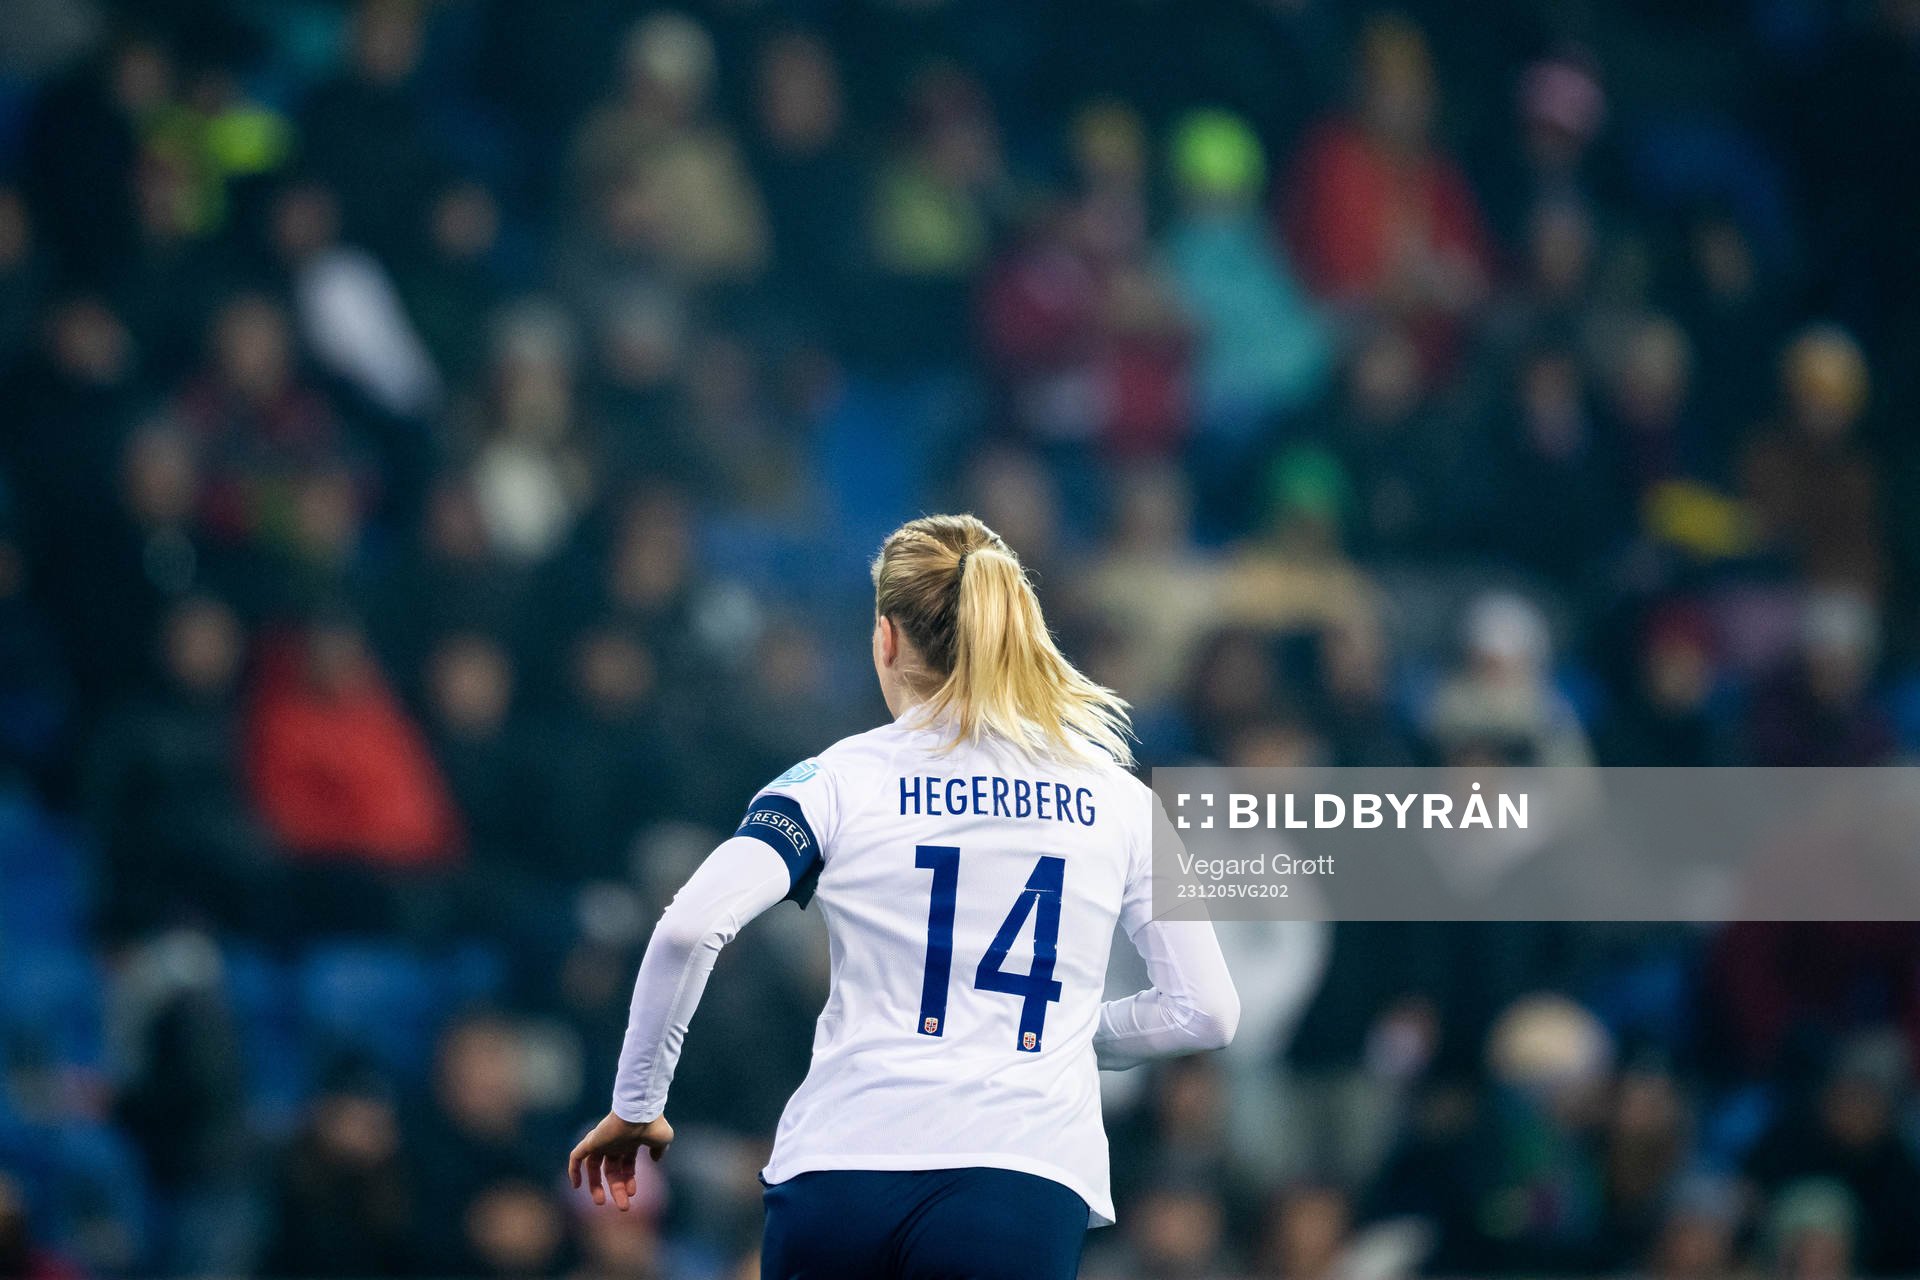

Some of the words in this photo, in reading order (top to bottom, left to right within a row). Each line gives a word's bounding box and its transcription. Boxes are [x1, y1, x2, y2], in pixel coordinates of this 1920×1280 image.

[900, 776, 1096, 827] HEGERBERG
[752, 812, 808, 851] RESPECT
[915, 845, 1066, 1053] 14
